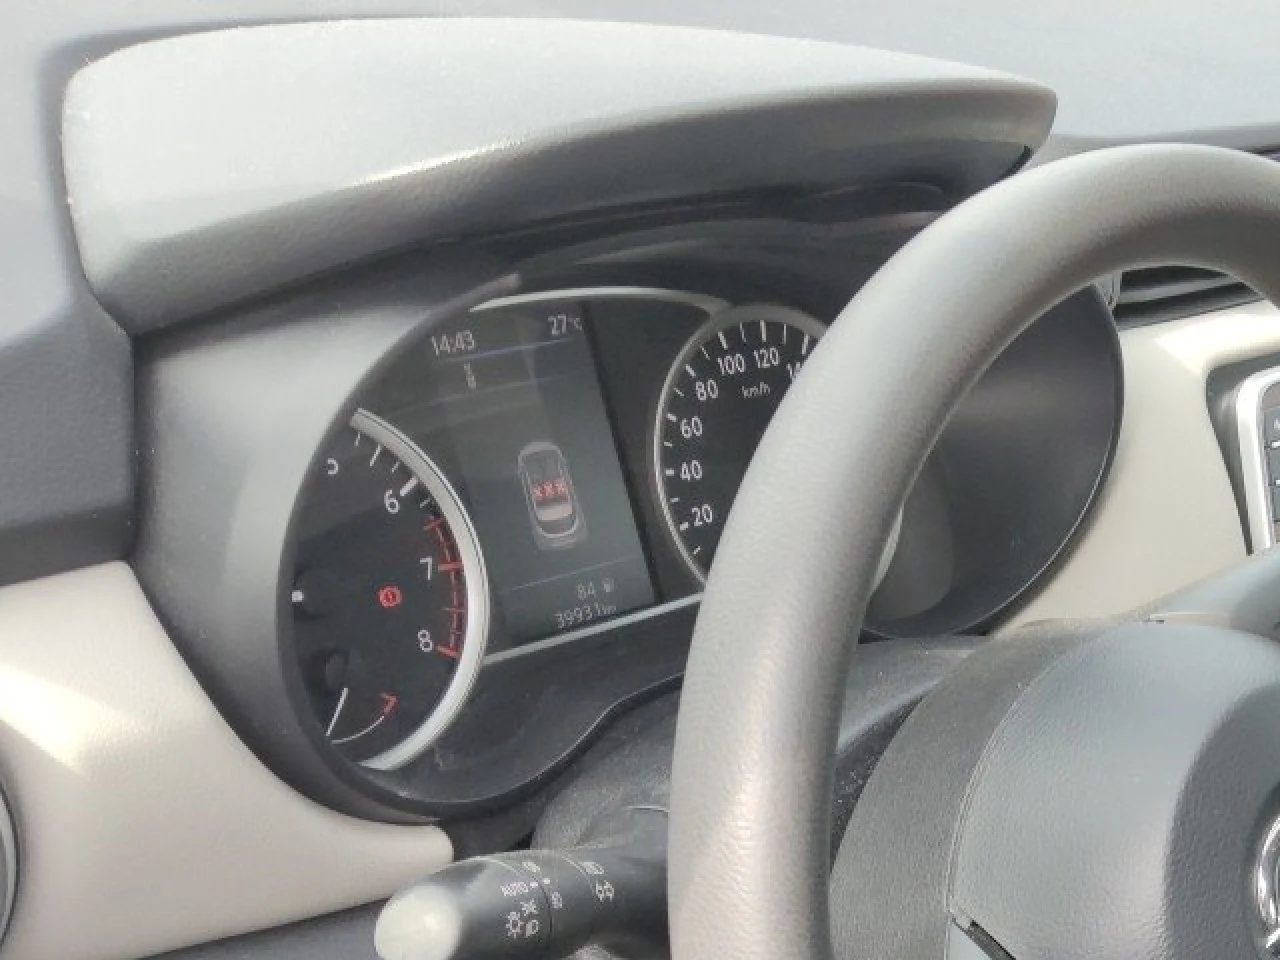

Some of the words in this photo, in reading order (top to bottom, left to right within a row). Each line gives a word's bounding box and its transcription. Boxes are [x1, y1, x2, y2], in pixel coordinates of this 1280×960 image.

[717, 353, 747, 375] 100
[753, 347, 780, 369] 120
[695, 379, 719, 401] 80
[741, 381, 771, 398] km/h
[680, 415, 703, 439] 60
[680, 459, 703, 482] 40
[383, 489, 400, 514] 6
[691, 503, 713, 526] 20
[419, 555, 433, 580] 7
[417, 629, 434, 653] 8
